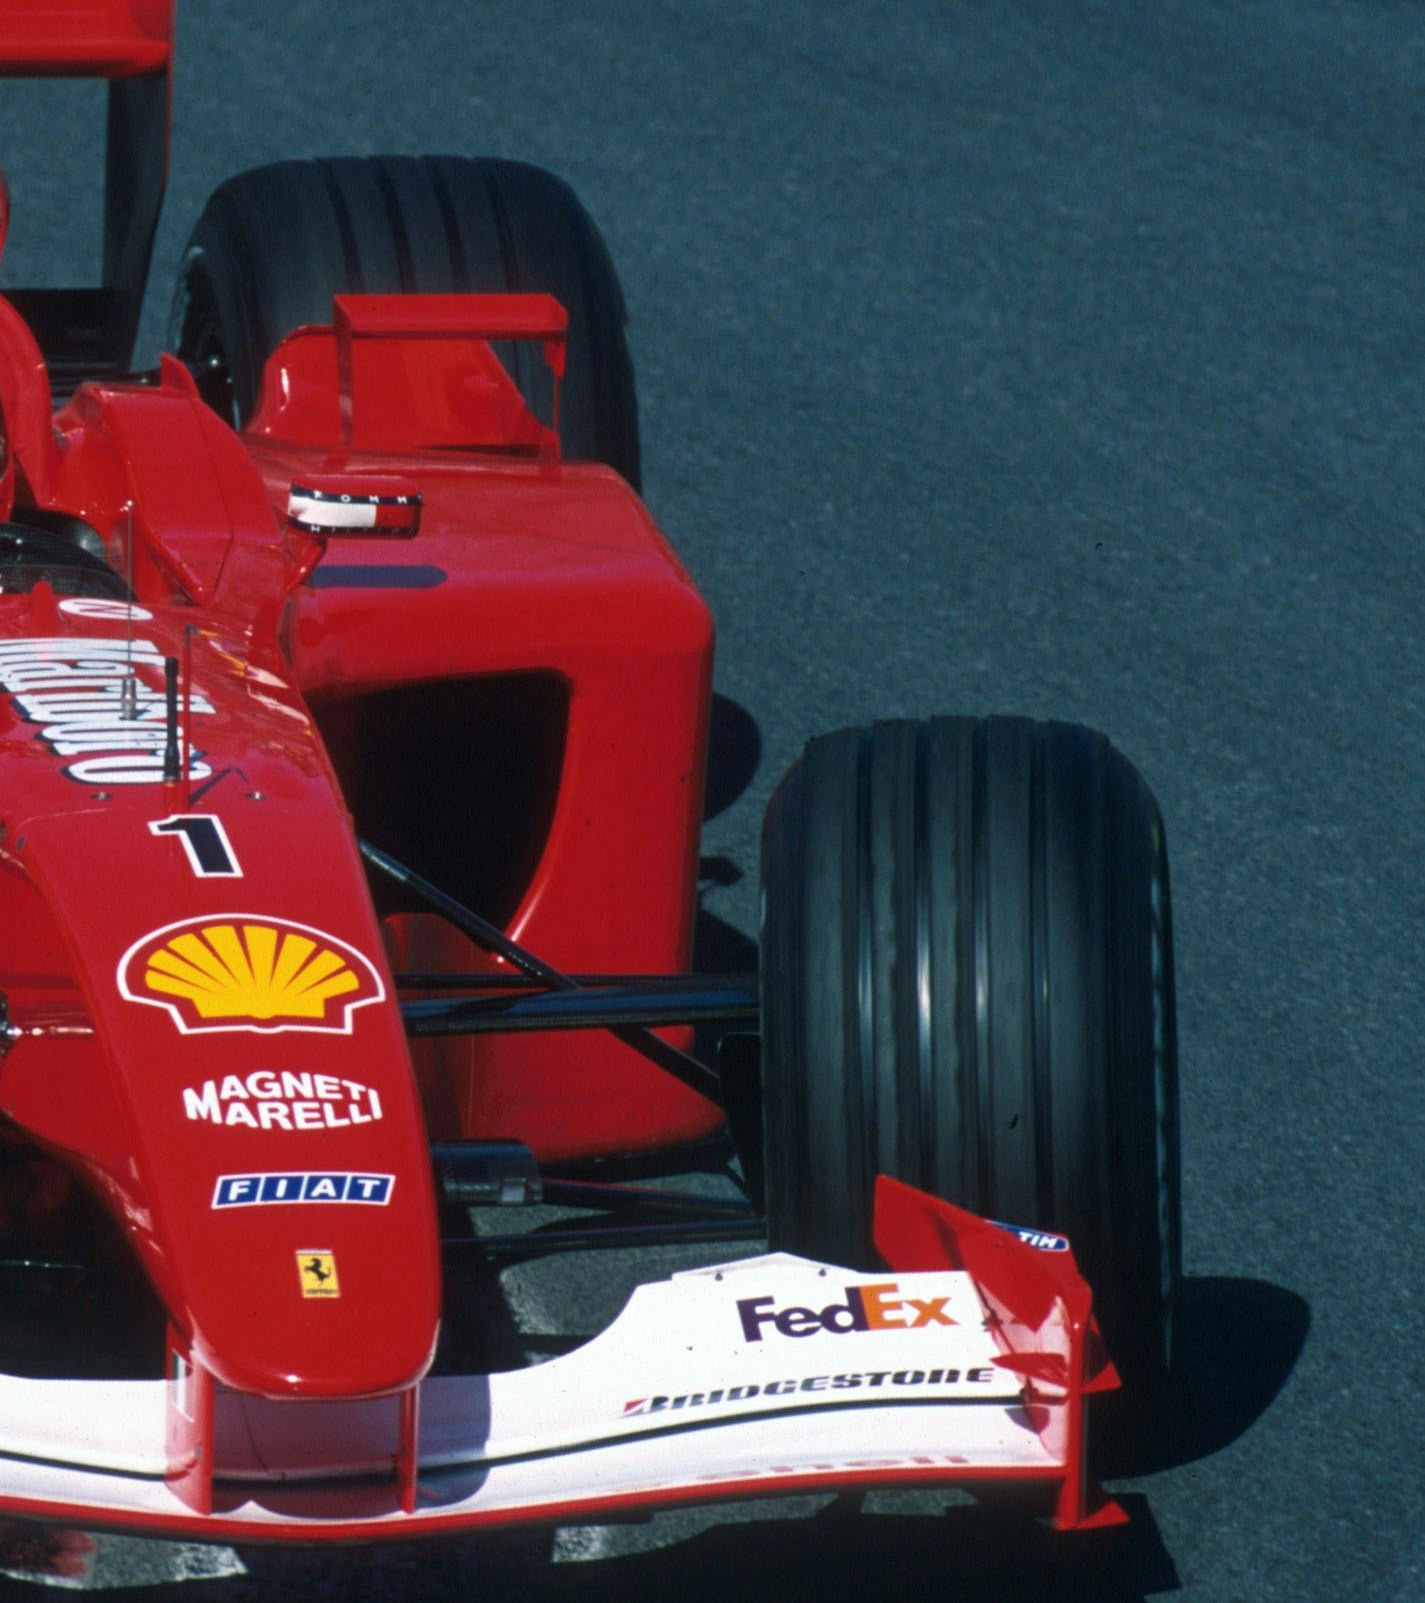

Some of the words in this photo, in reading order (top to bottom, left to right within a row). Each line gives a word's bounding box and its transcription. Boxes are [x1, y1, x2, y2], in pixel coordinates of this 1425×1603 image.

[148, 815, 243, 877] 1
[182, 1071, 383, 1124] MAGNETI
[182, 1079, 383, 1130] MARELLI
[228, 1178, 382, 1201] FIAT
[1019, 1231, 1058, 1249] TIM
[736, 1283, 960, 1342] FedEx
[622, 1367, 995, 1416] BRIDGESTONE
